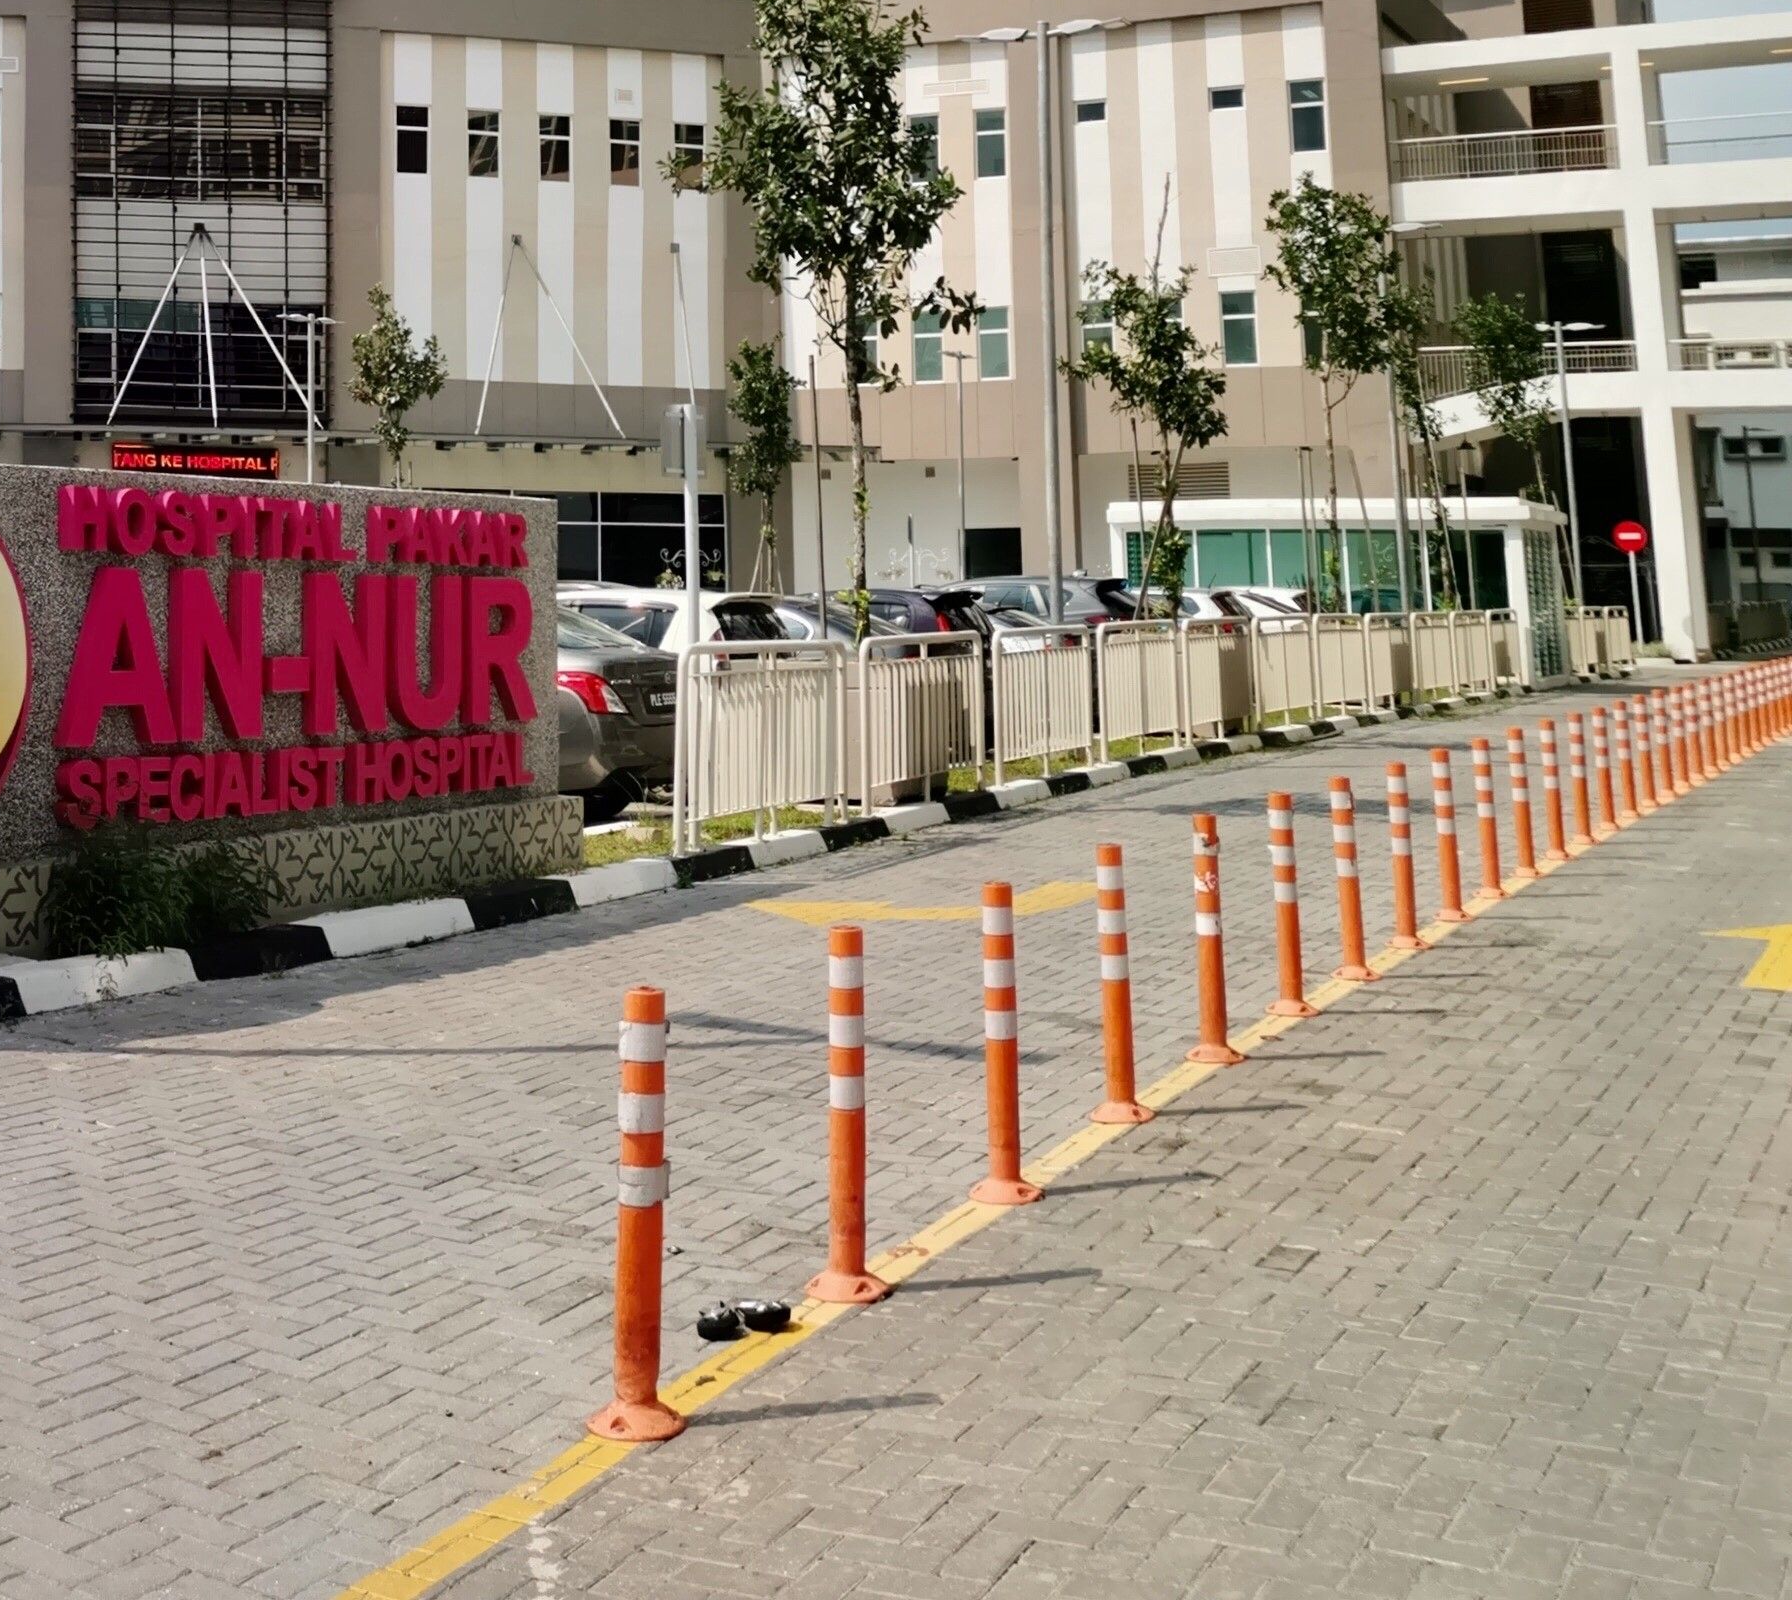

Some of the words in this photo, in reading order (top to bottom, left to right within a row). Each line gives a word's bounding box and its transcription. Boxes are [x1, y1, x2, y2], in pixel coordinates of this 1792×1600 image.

[161, 455, 183, 468] KE
[187, 456, 267, 470] HOSPITAL
[58, 484, 357, 562] HOSPITAL
[366, 505, 529, 567] PAKAR
[54, 566, 538, 747] AN-NUR
[56, 747, 345, 830] SPECIALIST
[345, 732, 535, 804] HOSPITAL
